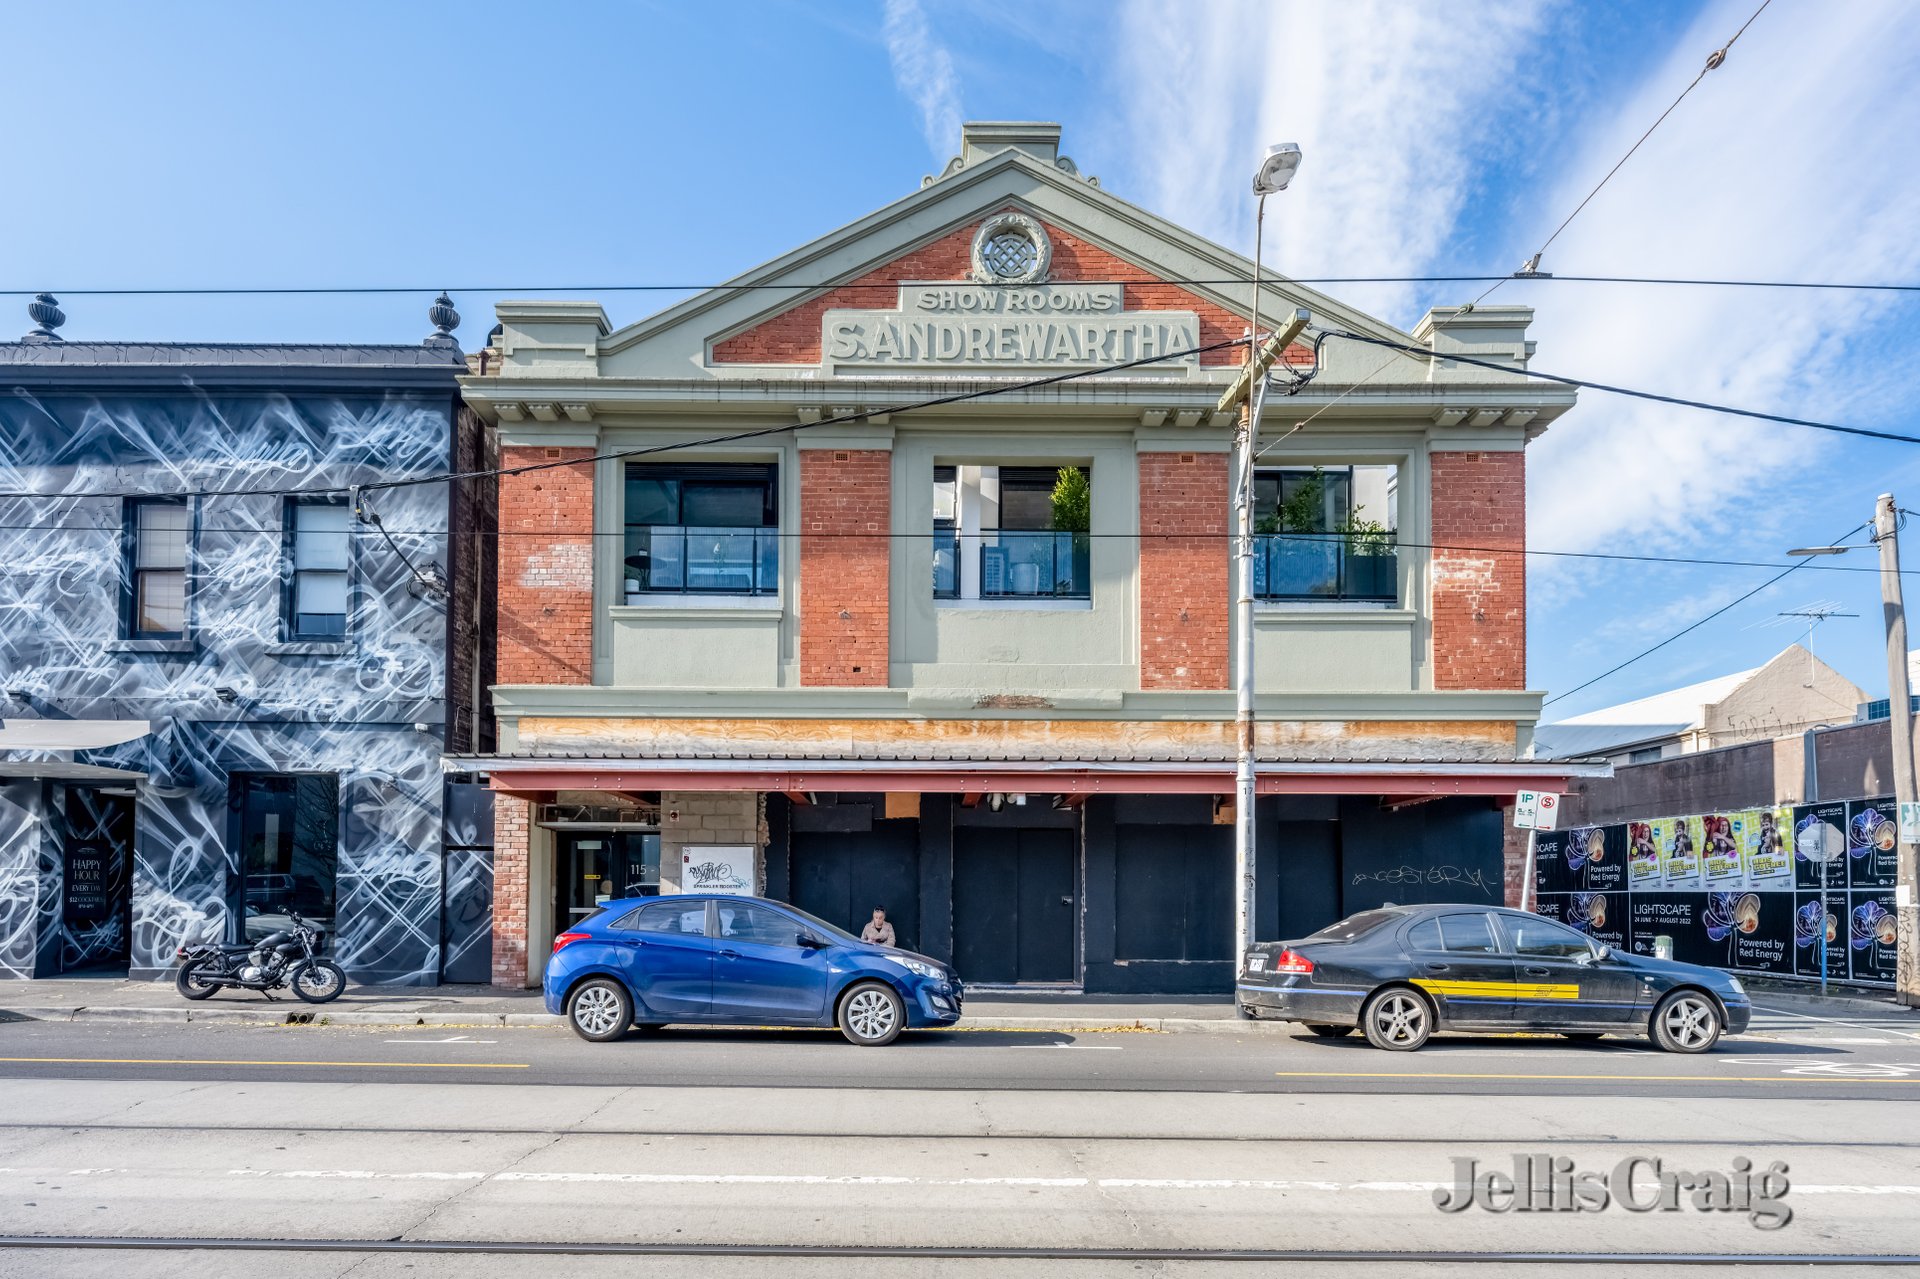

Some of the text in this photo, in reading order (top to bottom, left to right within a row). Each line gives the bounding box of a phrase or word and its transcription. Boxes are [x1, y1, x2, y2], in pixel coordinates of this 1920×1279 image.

[1521, 793, 1534, 803] 1P
[72, 859, 102, 870] HAPPY
[631, 864, 647, 875] 115
[1590, 864, 1622, 873] Powered by
[74, 870, 100, 880] HOUR
[1601, 873, 1620, 882] Energy
[71, 884, 89, 892] EVERY
[1536, 904, 1560, 914] SCAPE
[1634, 904, 1692, 916] LIGHTSCAPE
[1592, 931, 1623, 941] Powered by
[1739, 938, 1785, 951] Powered by
[1739, 949, 1783, 961] Red Energy
